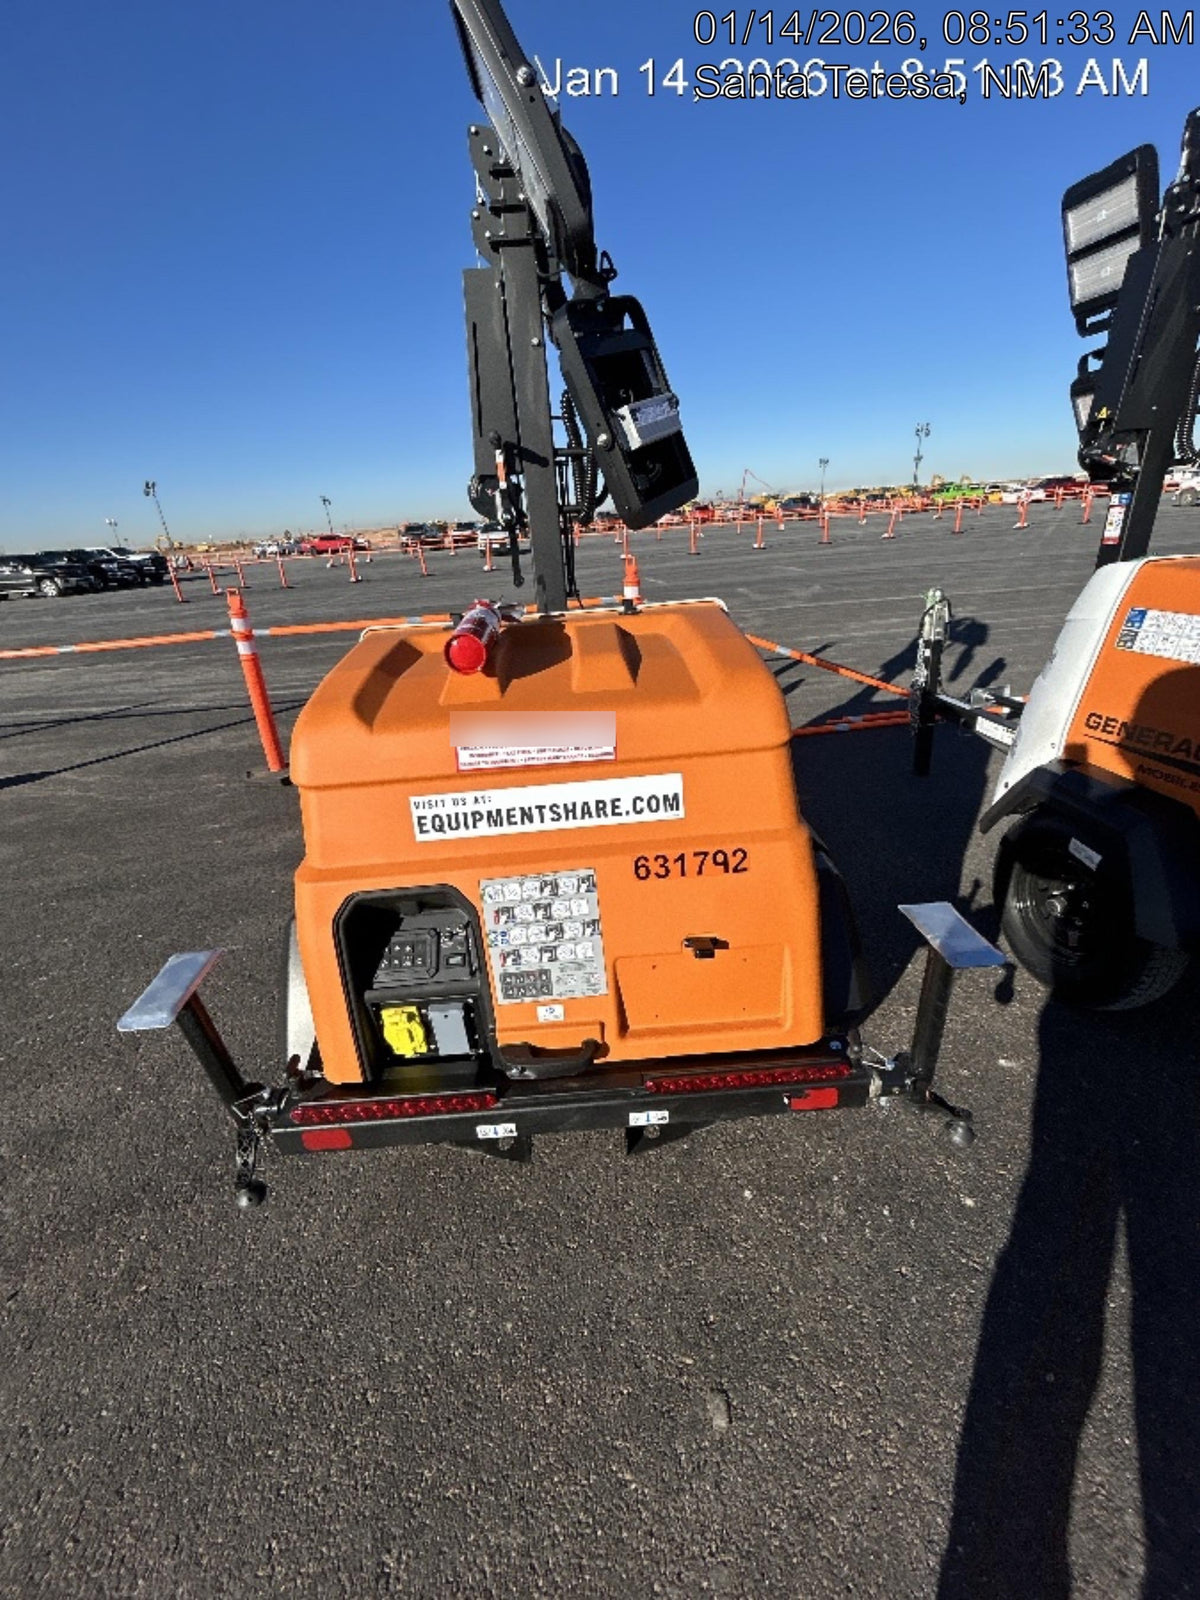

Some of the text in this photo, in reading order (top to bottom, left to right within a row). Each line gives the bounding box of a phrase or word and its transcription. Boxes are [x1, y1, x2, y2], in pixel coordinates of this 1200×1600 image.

[413, 799, 446, 810] VISIT
[451, 797, 467, 806] US
[416, 792, 681, 835] EQUIPMENTSHARE.COM
[633, 848, 749, 881] 631792
